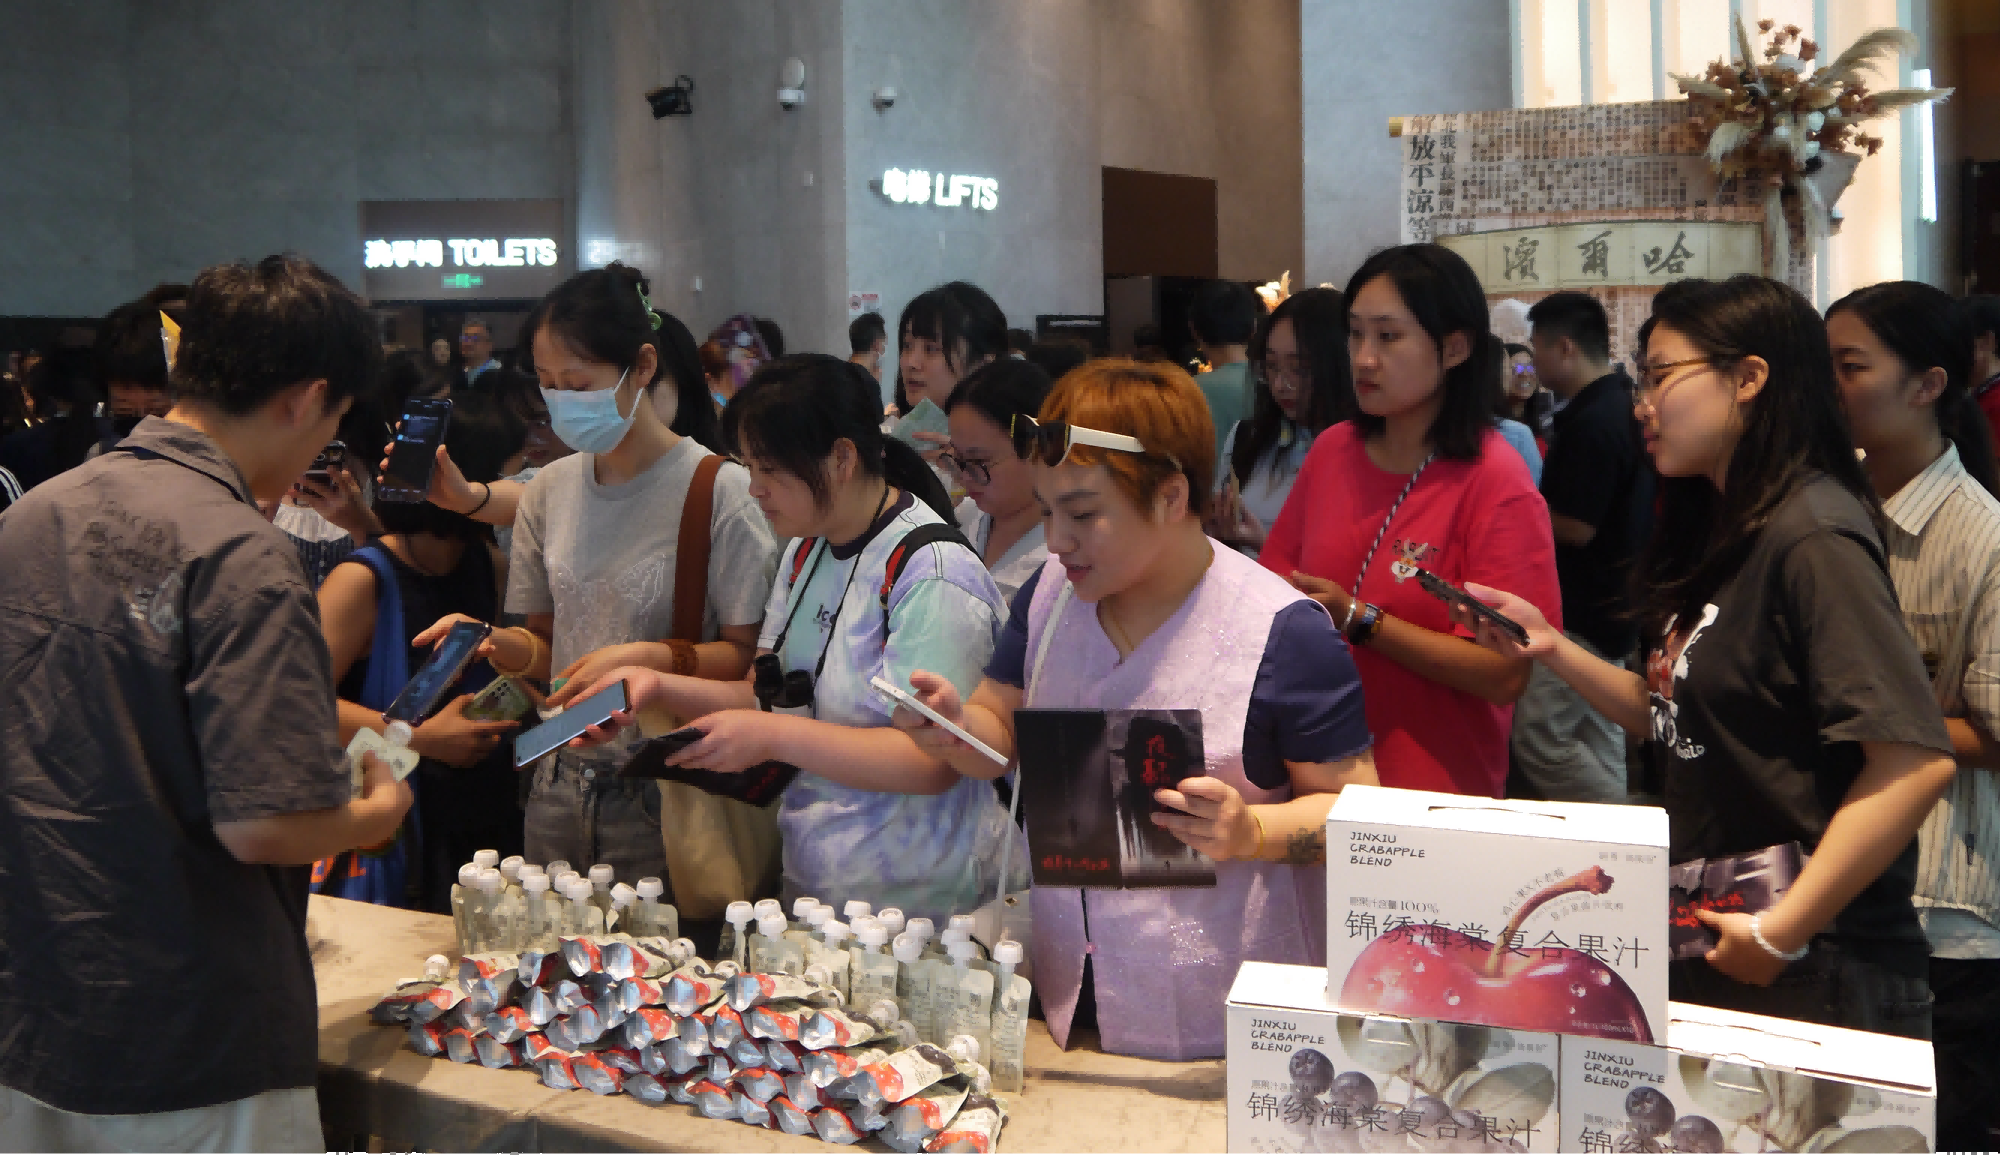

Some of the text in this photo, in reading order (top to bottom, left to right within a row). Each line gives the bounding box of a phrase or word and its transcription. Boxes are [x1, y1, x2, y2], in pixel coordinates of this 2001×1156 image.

[935, 172, 999, 211] LIFTS
[447, 237, 558, 267] TOILETS
[1350, 831, 1397, 844] JINXIU
[1350, 843, 1426, 858] CRABAPPLE
[1350, 855, 1393, 867] BLEND
[1345, 910, 1650, 969] 锦绣海棠复合果汁
[1251, 1018, 1297, 1031] JINXIU
[1251, 1030, 1325, 1045] CRABAPPLE
[1251, 1041, 1293, 1053] BLEND
[1584, 1049, 1634, 1066] JINXIU
[1584, 1061, 1666, 1084] CRABAPPLE
[1584, 1073, 1630, 1089] BLEND
[1247, 1091, 1541, 1149] 锦绣海棠复合果汁
